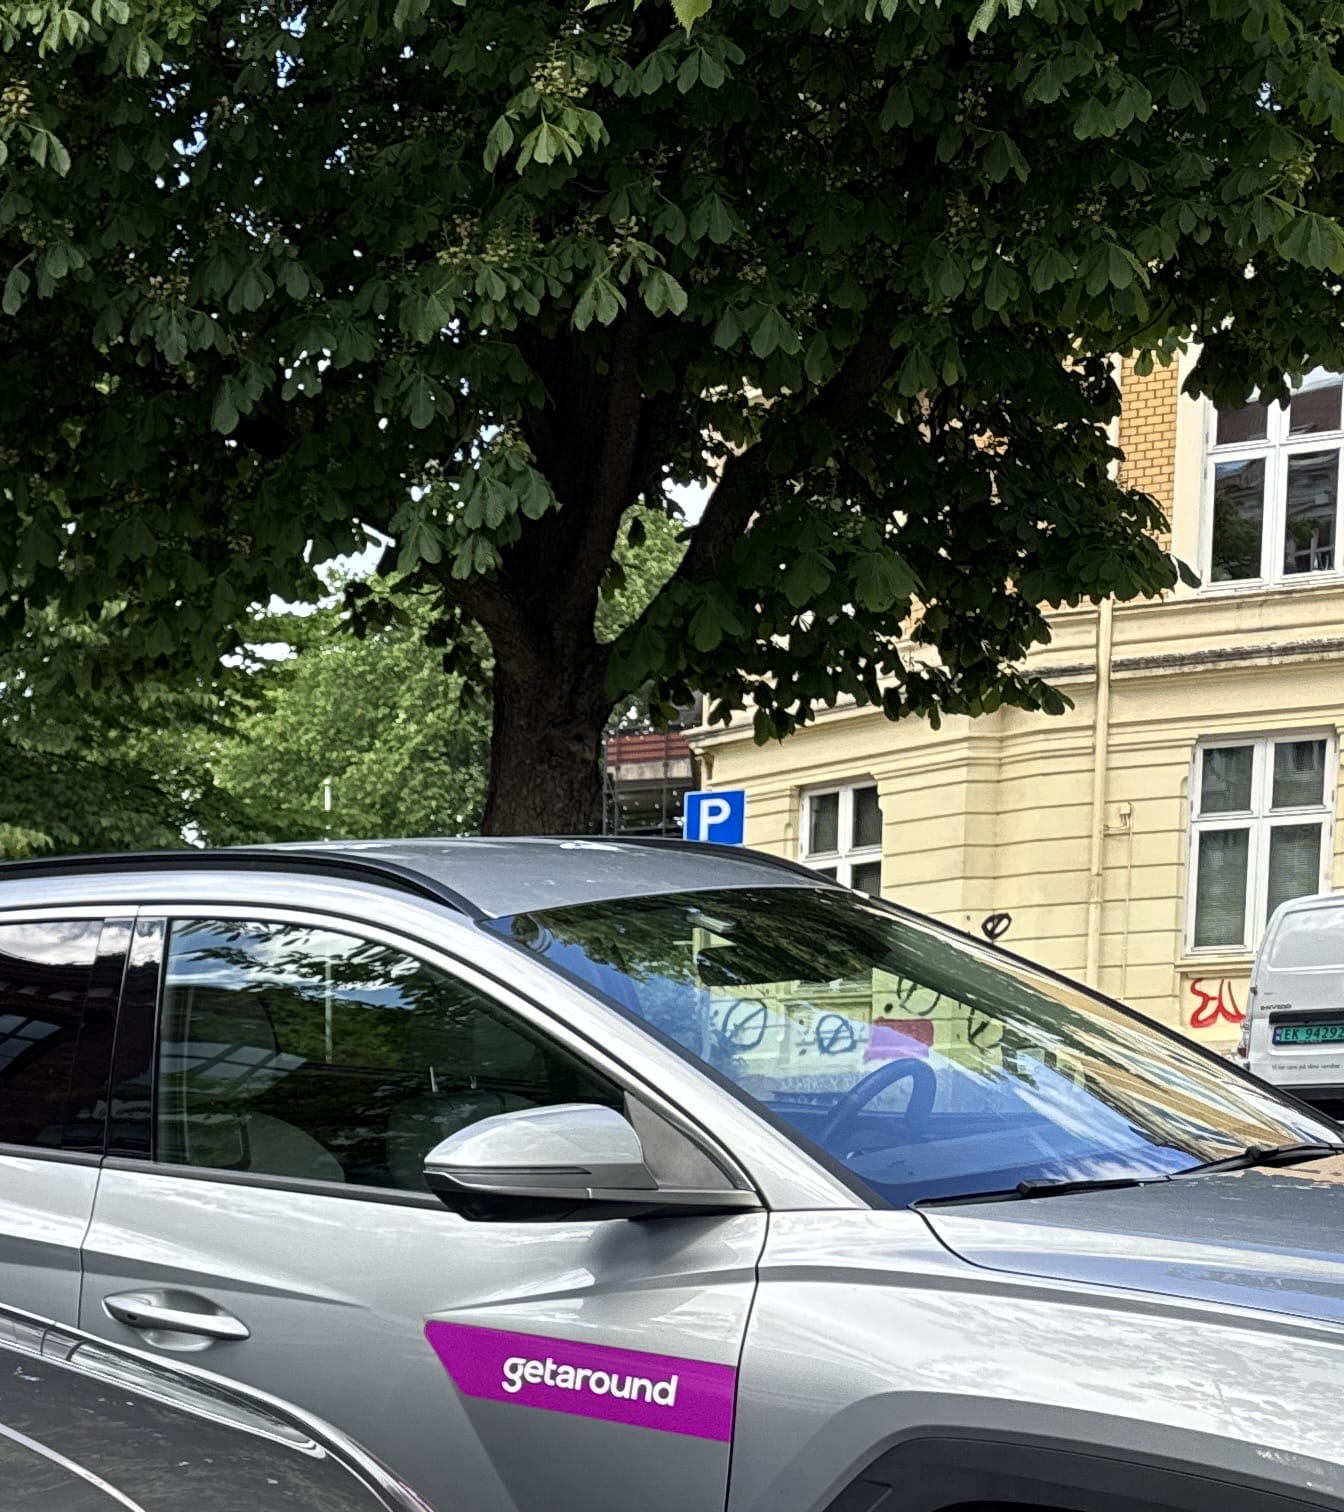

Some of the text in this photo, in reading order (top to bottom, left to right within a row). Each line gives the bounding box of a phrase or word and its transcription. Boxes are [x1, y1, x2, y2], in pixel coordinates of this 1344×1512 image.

[699, 798, 731, 842] P
[1284, 1028, 1299, 1040] EK
[501, 1356, 679, 1406] getaround
